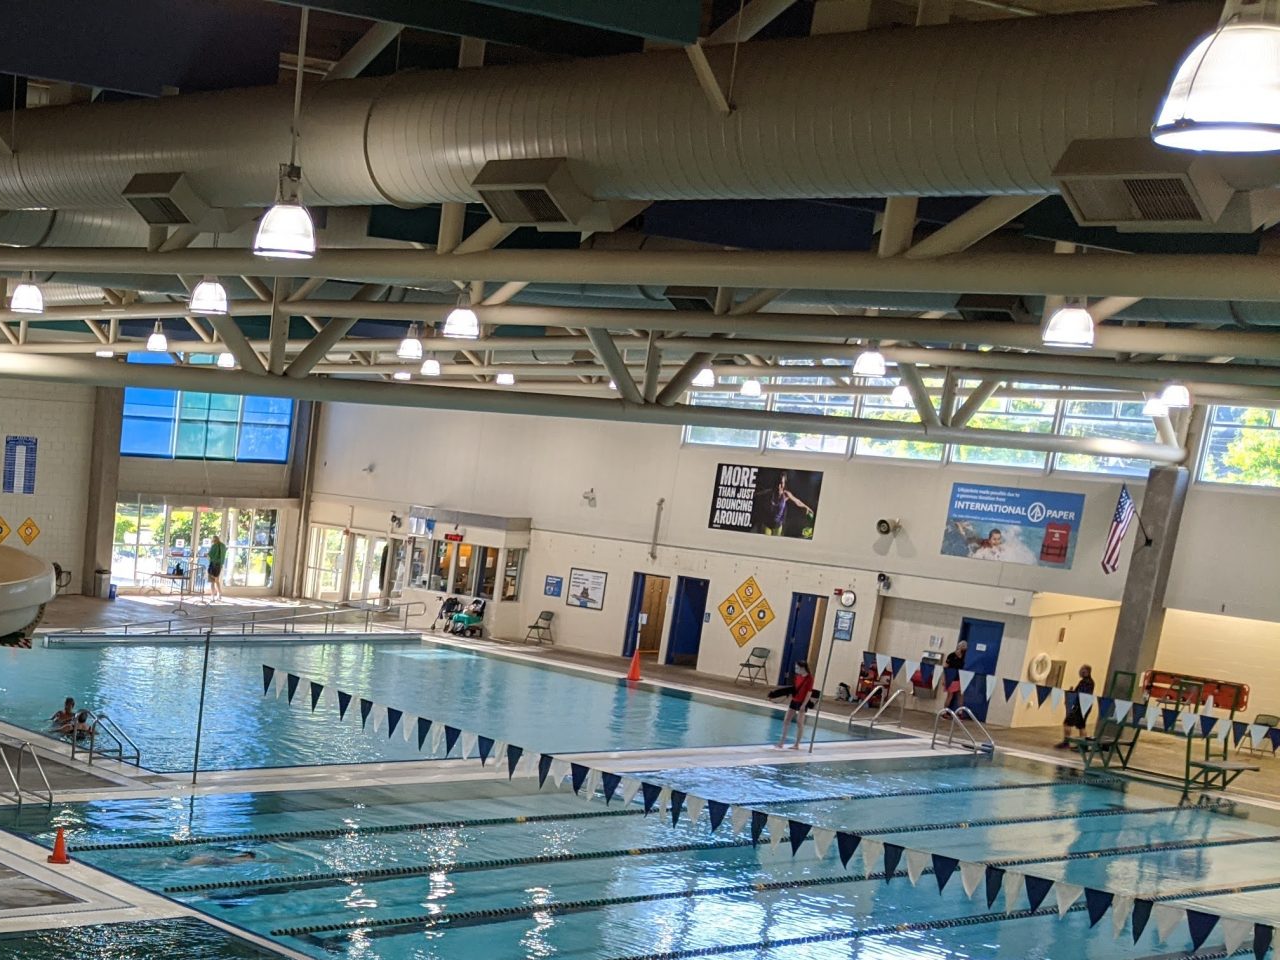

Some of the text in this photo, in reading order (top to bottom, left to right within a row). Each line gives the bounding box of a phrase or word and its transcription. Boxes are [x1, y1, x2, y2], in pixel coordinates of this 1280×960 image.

[720, 465, 758, 488] MORE
[718, 486, 756, 500] THAN JUST
[716, 497, 754, 512] BOUNCING
[954, 501, 1076, 520] INTERNATIONAL PAPER
[713, 510, 753, 527] AROUND.
